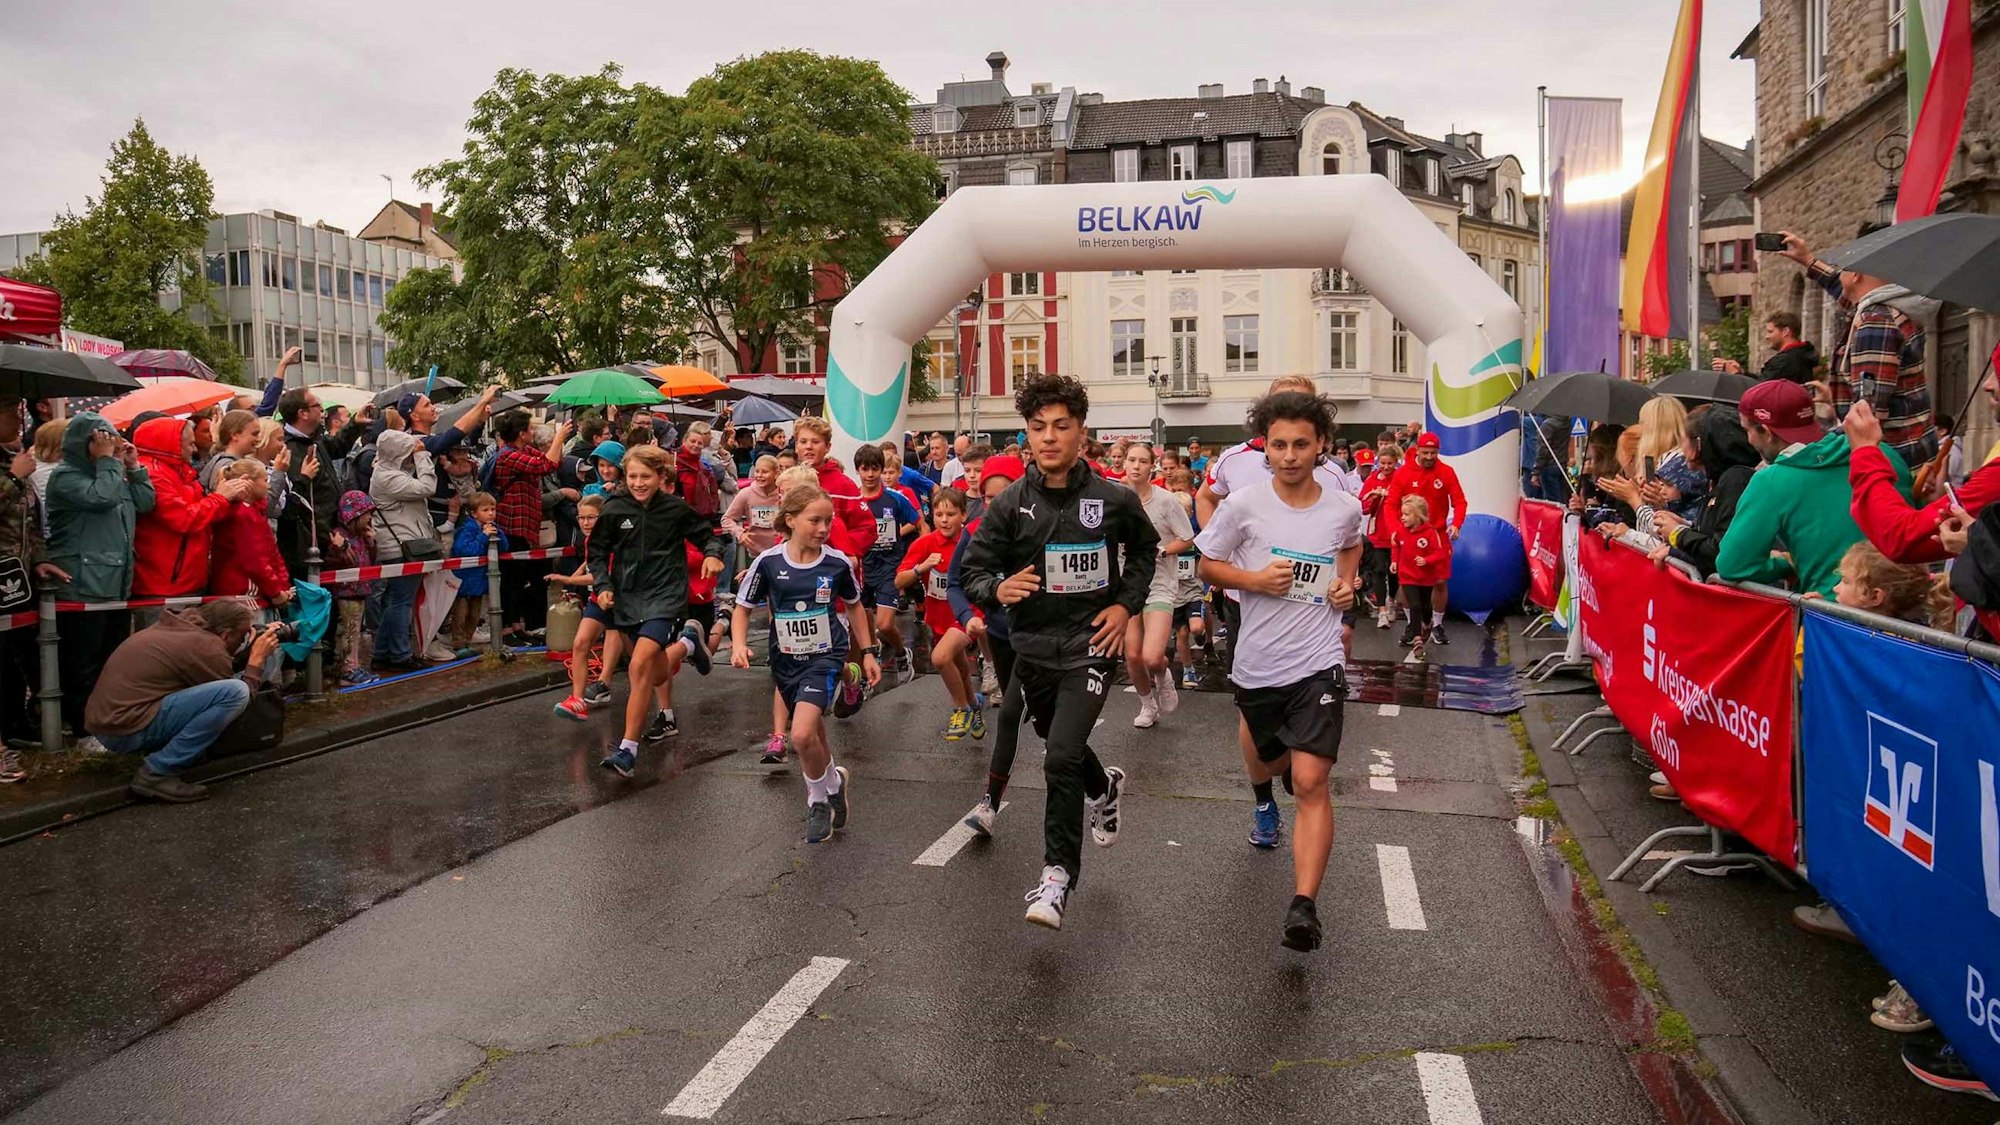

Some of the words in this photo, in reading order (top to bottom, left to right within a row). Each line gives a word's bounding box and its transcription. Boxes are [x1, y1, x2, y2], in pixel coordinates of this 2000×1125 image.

[1078, 204, 1203, 233] BELKAW
[1078, 238, 1091, 248] Im
[1093, 238, 1130, 248] Herzen
[1132, 236, 1178, 249] bergisch.
[79, 339, 96, 352] LODY
[1061, 552, 1099, 573] 1488
[1289, 560, 1321, 583] 487
[2, 591, 26, 602] adidas
[786, 618, 818, 637] 1405
[1087, 678, 1103, 695] DD
[1658, 650, 1770, 757] Kreissparkasse
[1650, 712, 1680, 771] Köln
